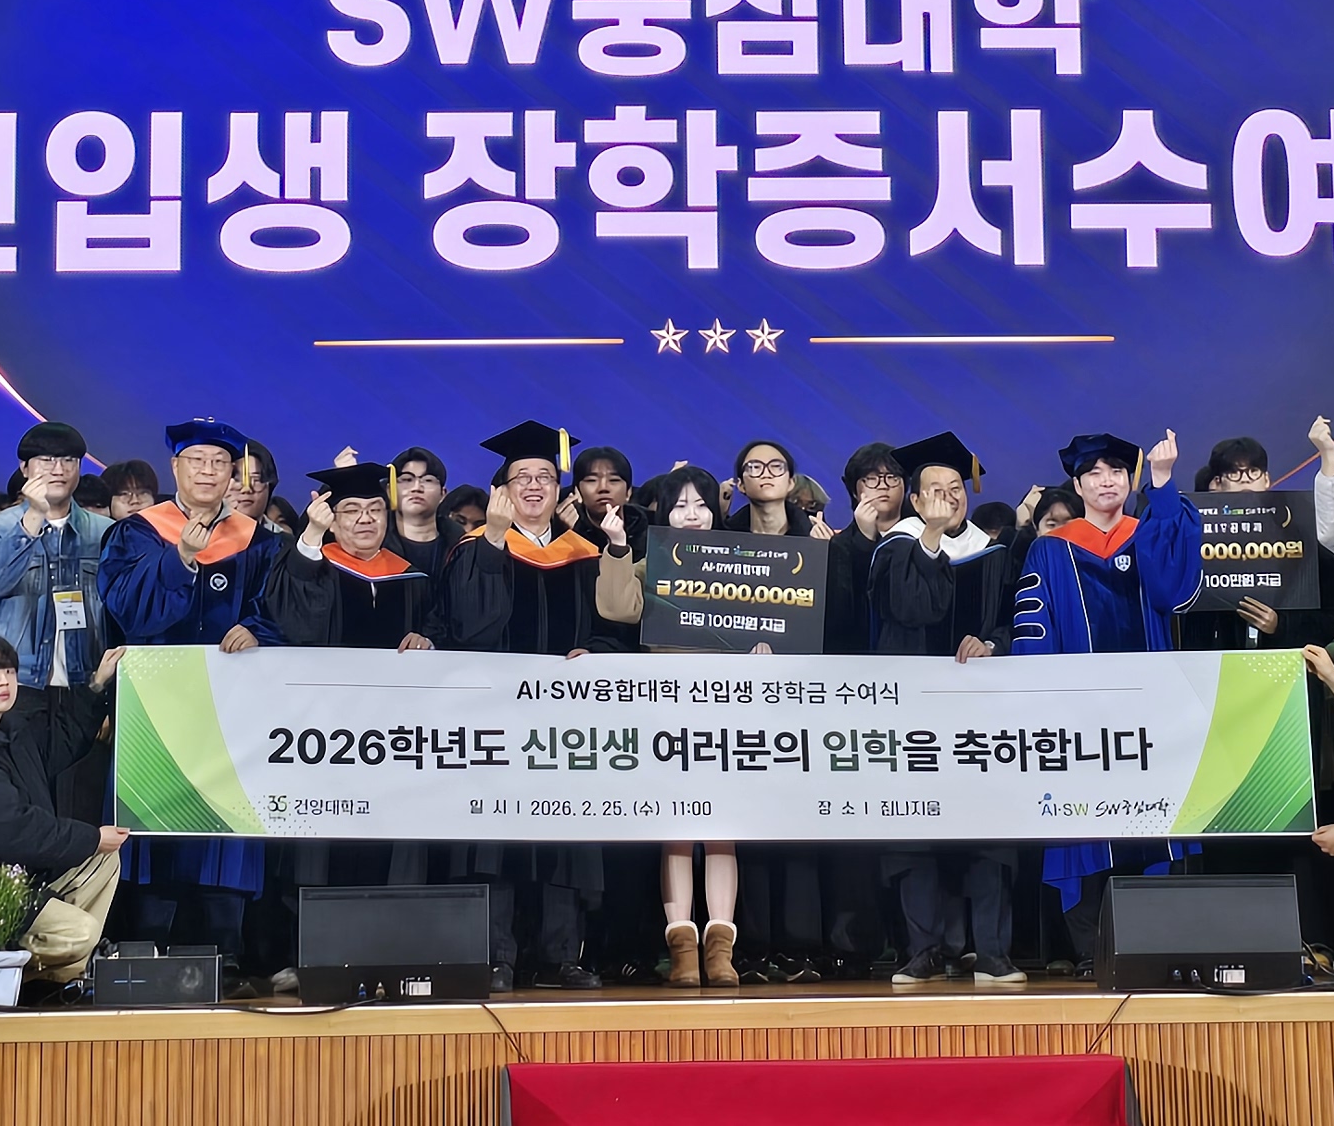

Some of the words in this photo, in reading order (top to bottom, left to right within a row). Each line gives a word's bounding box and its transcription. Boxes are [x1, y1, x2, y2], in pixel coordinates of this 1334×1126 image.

[1200, 540, 1304, 561] 000,000원
[1256, 573, 1282, 587] 지급
[674, 580, 814, 607] 212,000,000원
[760, 617, 785, 633] 지급
[516, 678, 681, 704] AI·SW융합대학
[688, 679, 753, 704] 신입생
[761, 680, 828, 705] 장학금
[834, 681, 900, 706] 수여식
[267, 725, 510, 771] 2026학년도
[520, 726, 640, 772] 신입생
[652, 727, 810, 773] 여러분의
[822, 728, 942, 773] 입학을
[952, 726, 1154, 773] 축하합니다
[293, 798, 371, 816] 건양대학교
[492, 799, 507, 815] 시
[530, 800, 577, 817] 2026.
[581, 800, 597, 817] 2.
[602, 800, 628, 817] 25.
[633, 800, 660, 817] (수)
[671, 800, 712, 817] 11:00
[841, 800, 856, 816] 소
